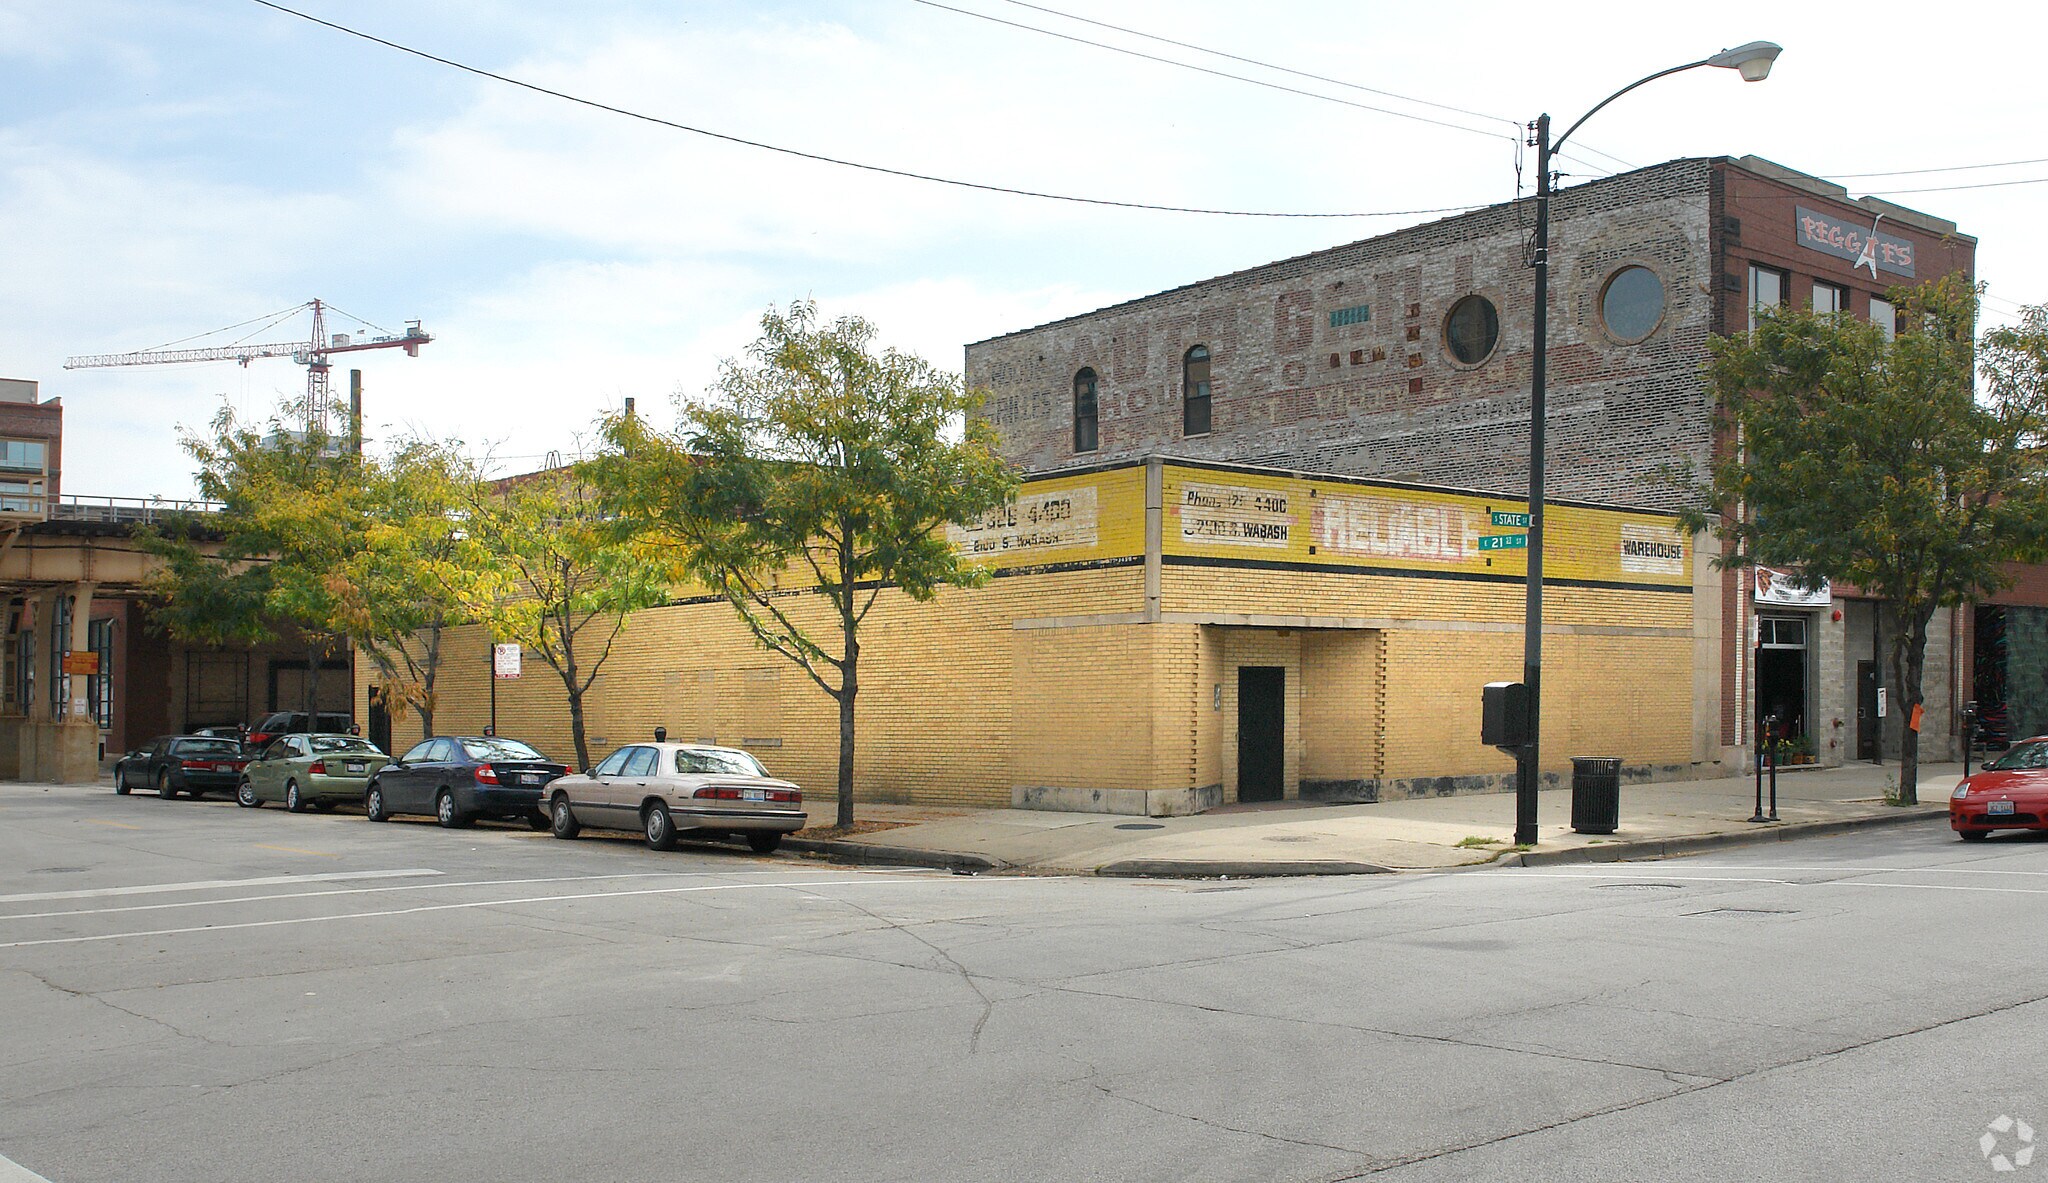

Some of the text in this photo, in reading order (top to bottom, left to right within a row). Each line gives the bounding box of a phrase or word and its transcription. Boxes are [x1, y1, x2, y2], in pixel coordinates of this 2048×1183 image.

[1499, 513, 1521, 526] STATE
[1243, 522, 1288, 540] WABASH
[1623, 539, 1682, 559] WAREHOUSE
